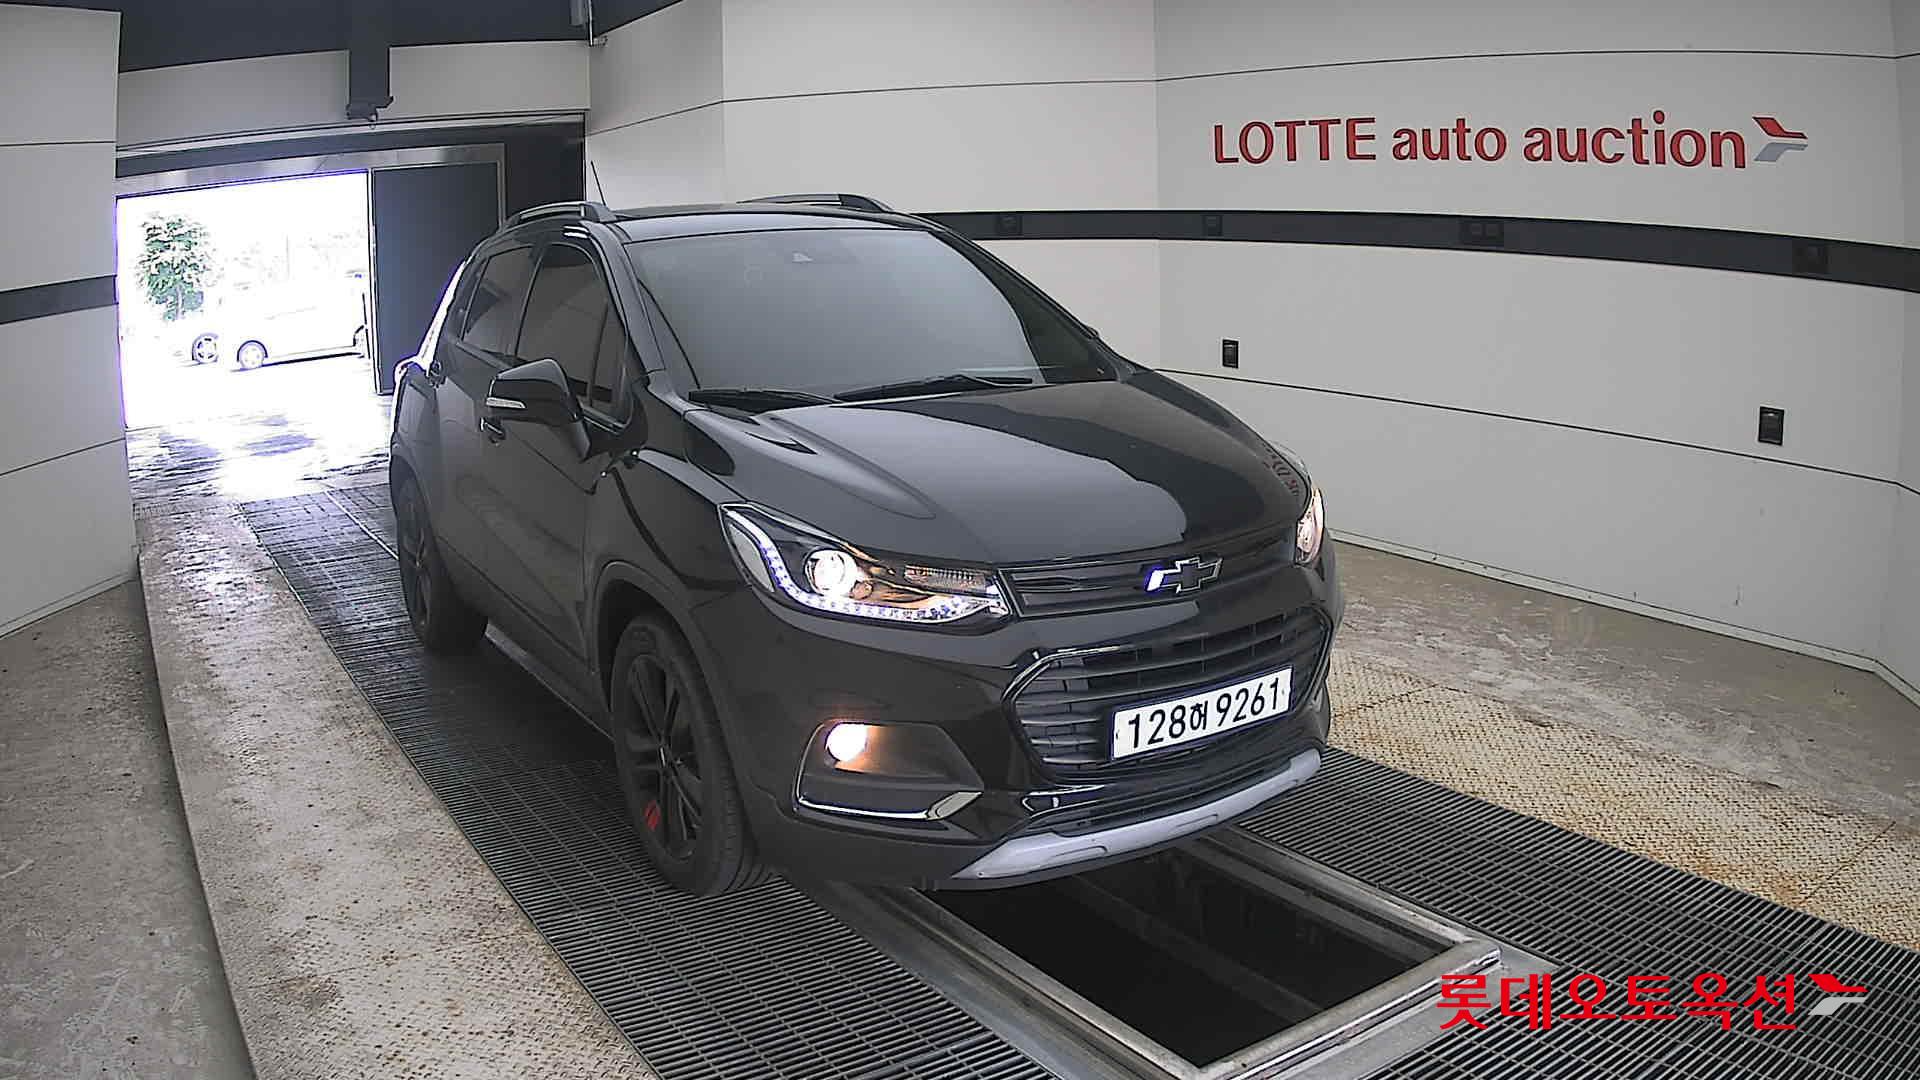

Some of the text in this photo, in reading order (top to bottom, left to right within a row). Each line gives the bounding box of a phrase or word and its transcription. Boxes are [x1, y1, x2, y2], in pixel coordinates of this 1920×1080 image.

[1213, 110, 1746, 168] LOTTE auto auction
